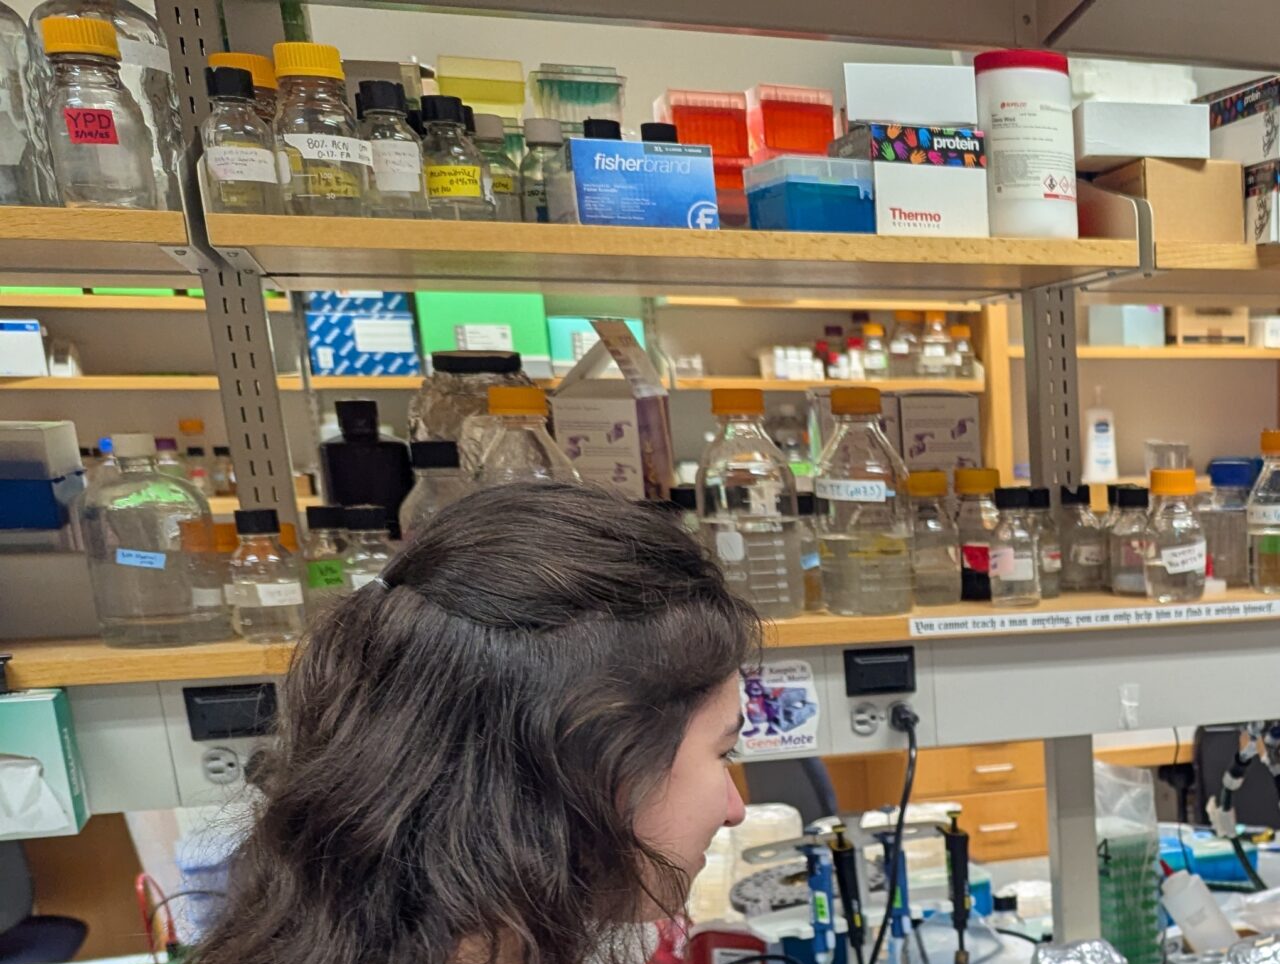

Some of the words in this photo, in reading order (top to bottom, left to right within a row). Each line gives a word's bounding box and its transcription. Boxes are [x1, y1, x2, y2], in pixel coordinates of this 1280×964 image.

[66, 112, 111, 129] YPD
[306, 138, 328, 150] 80%
[933, 136, 980, 151] protein
[594, 152, 691, 174] fisherbrand
[889, 207, 942, 223] Thermo
[914, 620, 935, 634] You
[938, 619, 969, 631] cannot
[972, 618, 996, 632] teach
[1009, 617, 1028, 628] man
[1095, 613, 1110, 623] can
[1113, 611, 1132, 624] only
[1134, 610, 1153, 622] help
[746, 734, 813, 748] GeneMate
